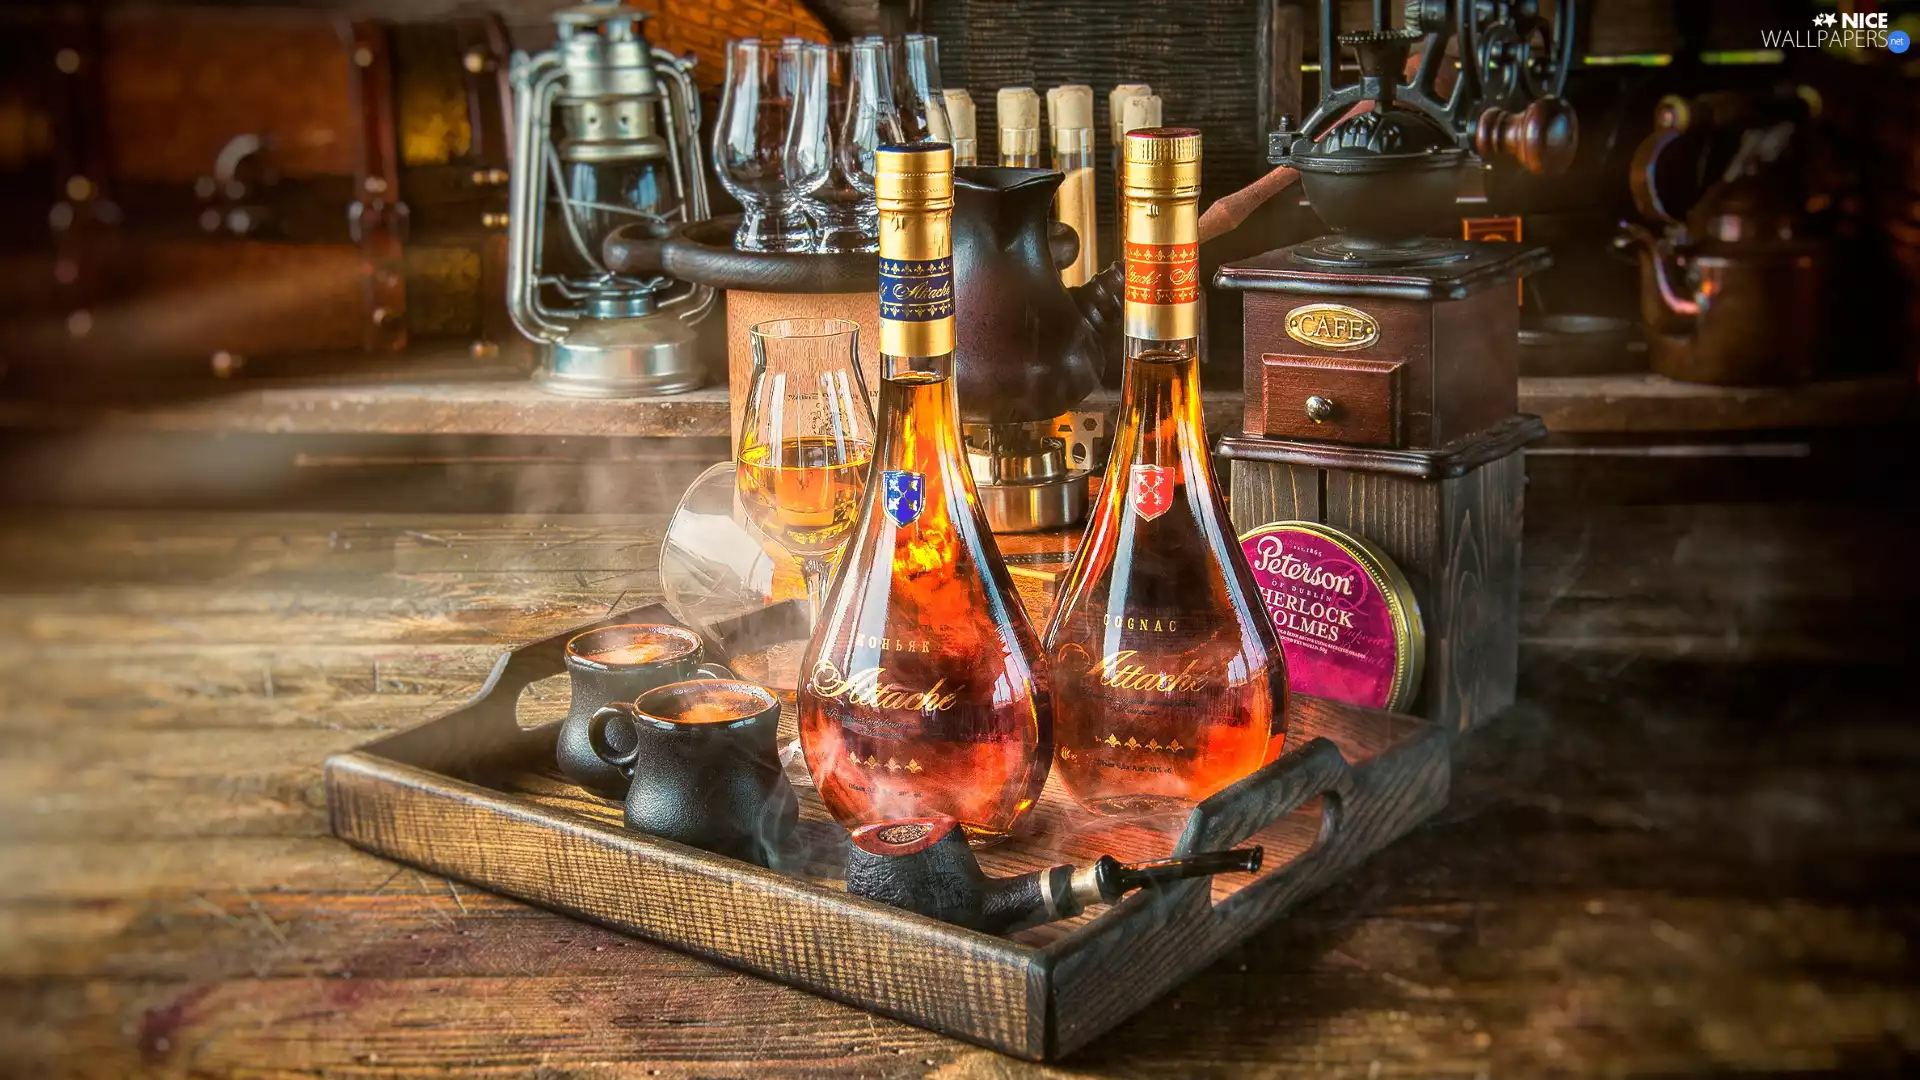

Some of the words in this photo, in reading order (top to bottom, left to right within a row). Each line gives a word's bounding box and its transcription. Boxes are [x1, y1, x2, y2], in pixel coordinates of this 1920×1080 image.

[1298, 314, 1365, 340] CAFE
[1254, 535, 1352, 595] Peterson
[1271, 580, 1285, 589] OF
[1292, 585, 1332, 602] DUBLIN
[1103, 613, 1177, 632] COGNAC
[1259, 587, 1355, 628] HERLOCK
[1267, 605, 1340, 642] OLMES
